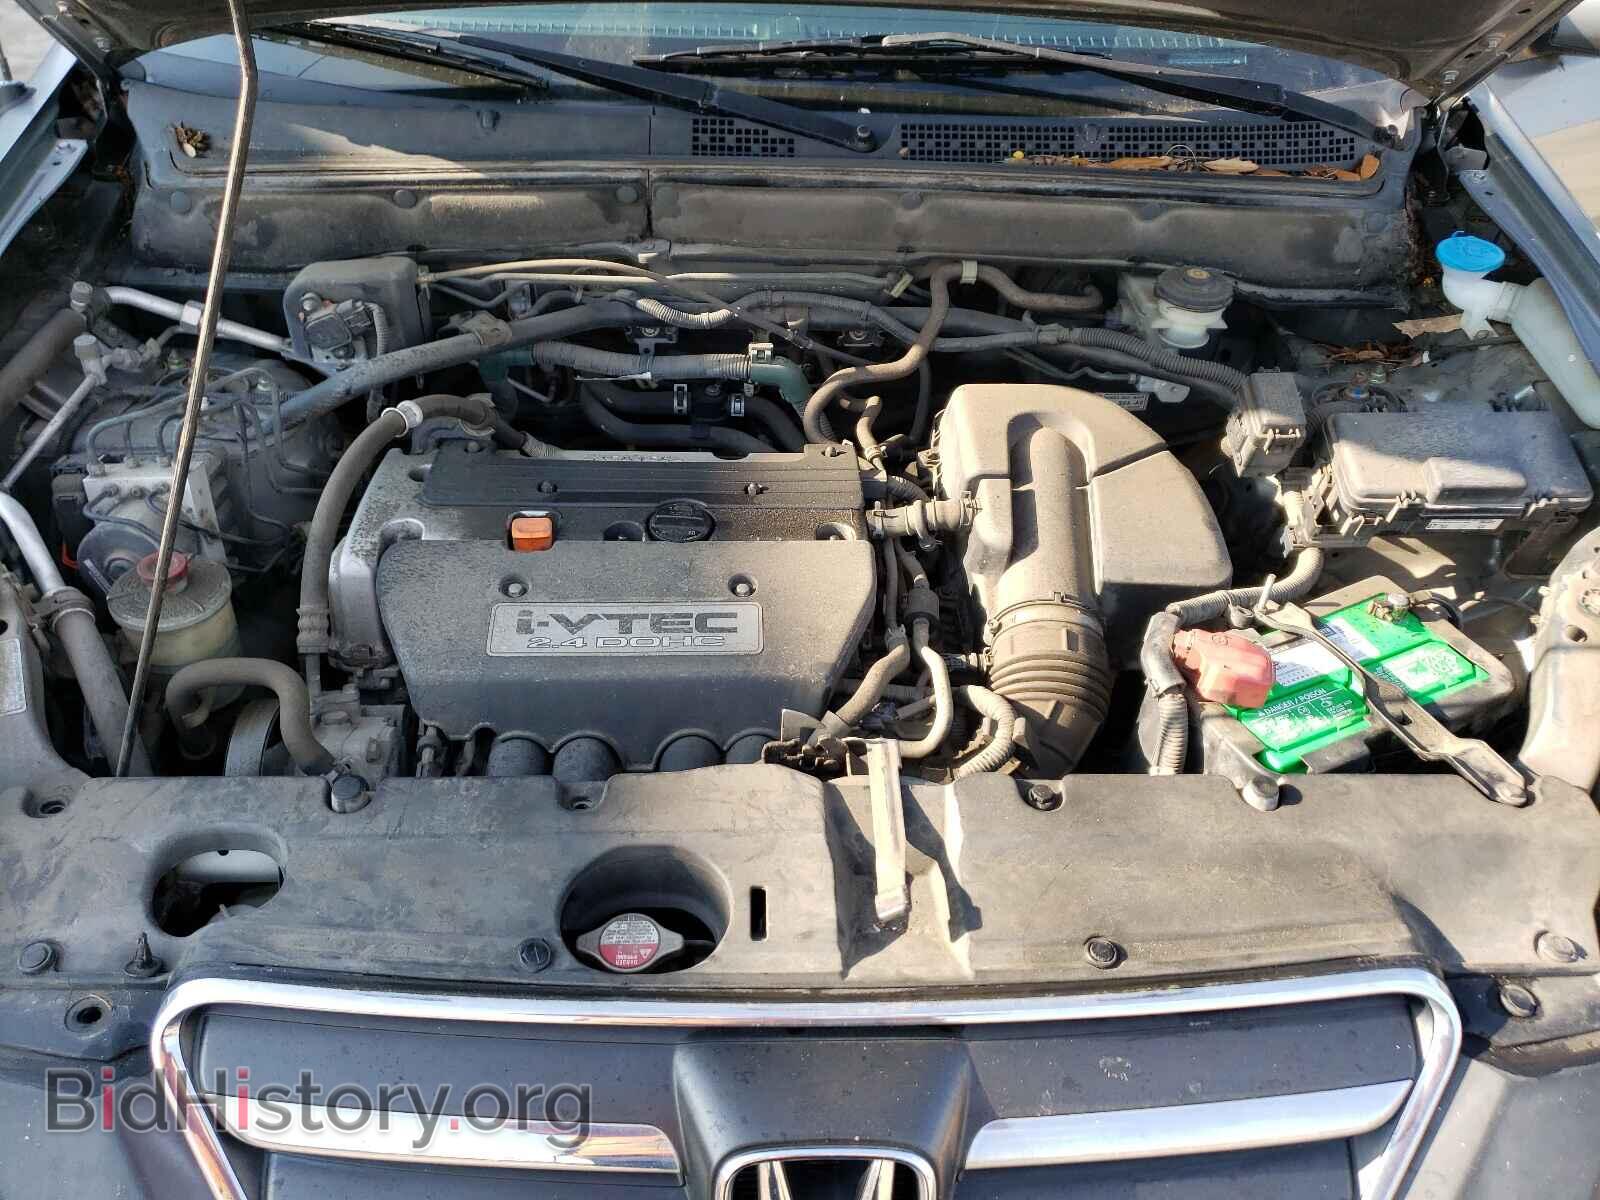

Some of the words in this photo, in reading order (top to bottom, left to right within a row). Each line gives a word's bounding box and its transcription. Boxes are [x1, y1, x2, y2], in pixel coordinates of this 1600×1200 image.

[516, 610, 738, 635] i-VTEC
[527, 637, 587, 649] 2.4
[596, 637, 724, 649] DOHC
[1263, 700, 1296, 714] DANGER
[1300, 688, 1327, 702] POISON
